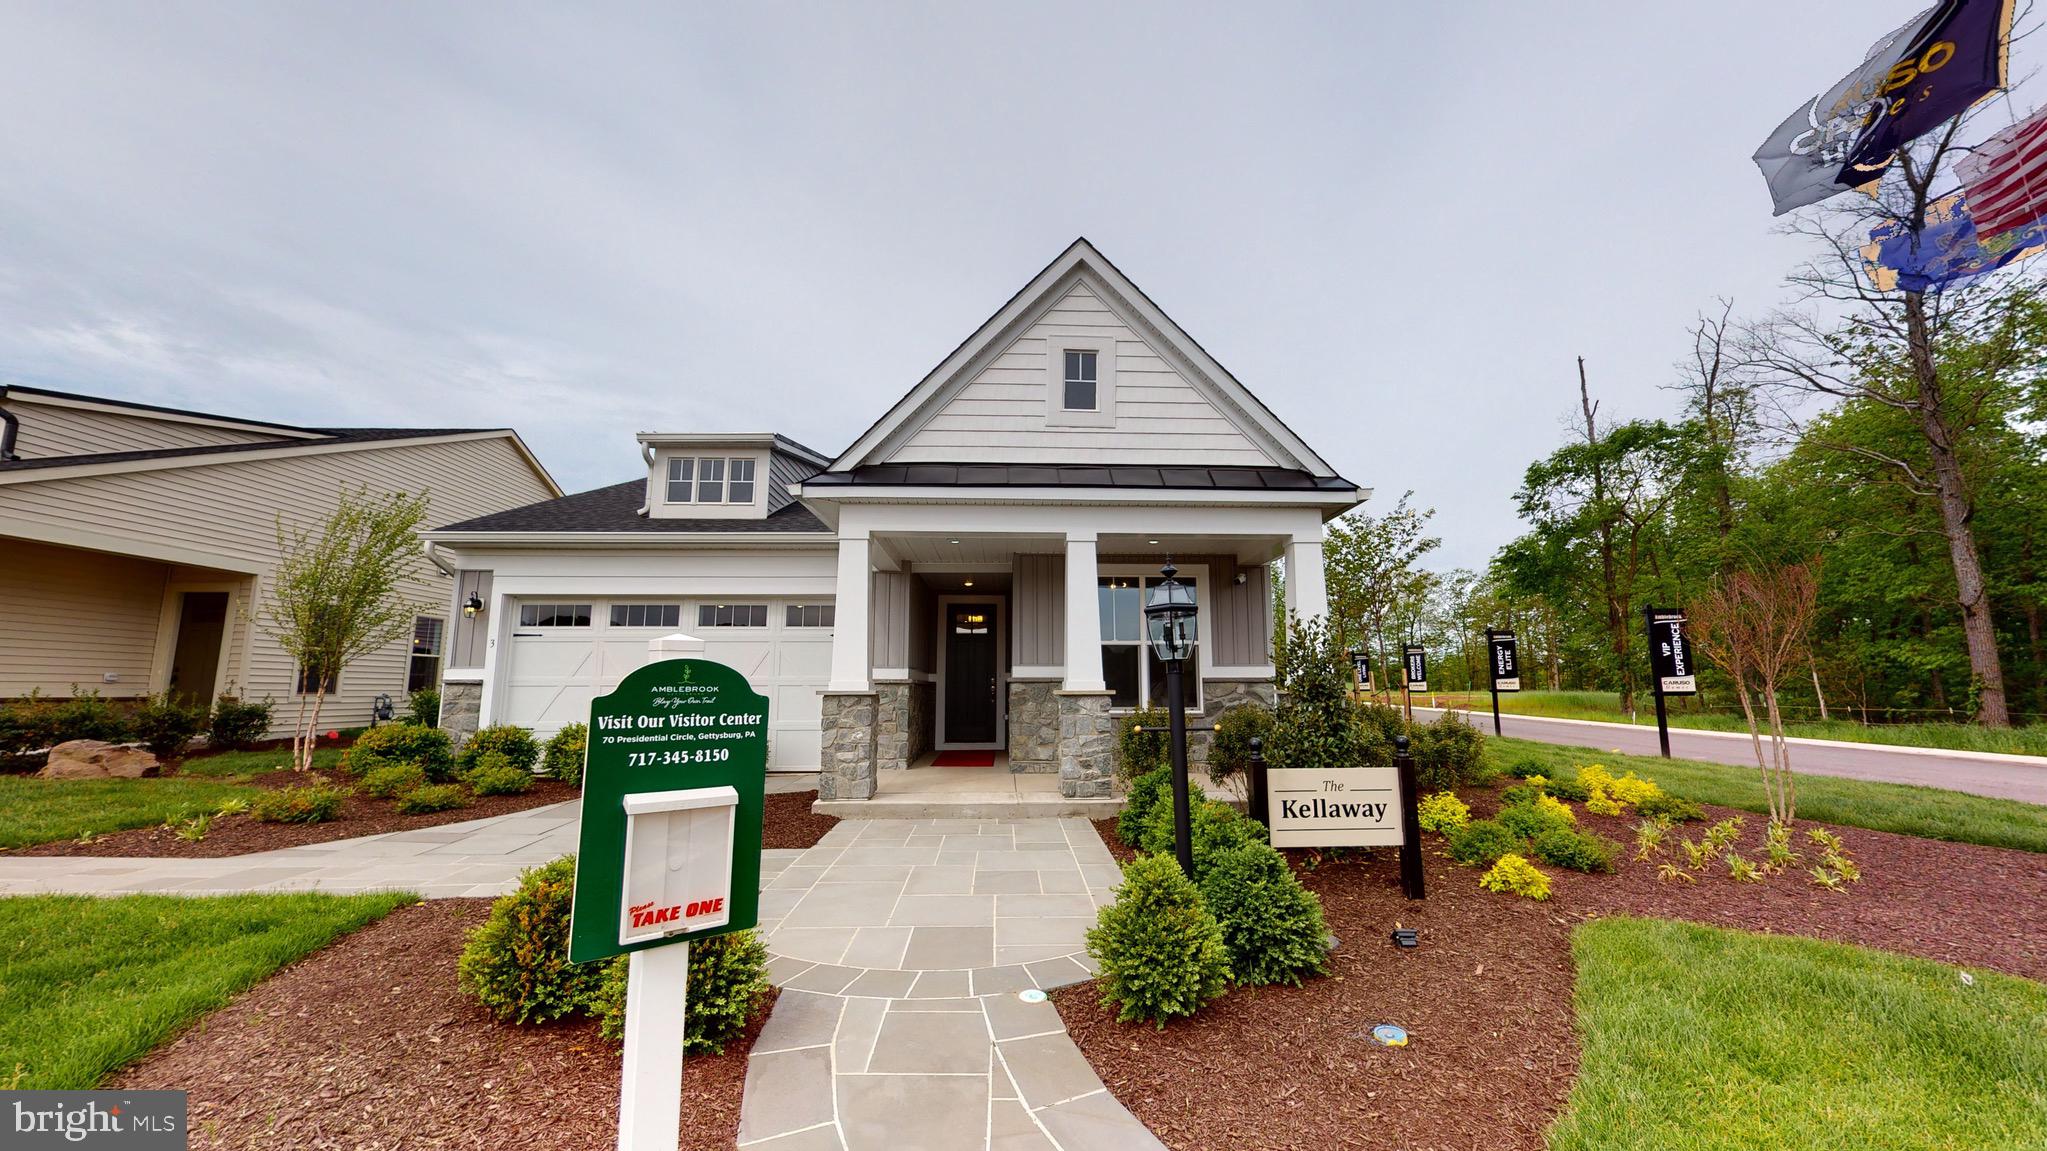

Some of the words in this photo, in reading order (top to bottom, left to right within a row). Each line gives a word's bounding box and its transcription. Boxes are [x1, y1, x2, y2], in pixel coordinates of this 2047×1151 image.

[1661, 642, 1671, 657] VIP
[1670, 623, 1686, 676] EXPERIENCE
[1496, 645, 1505, 675] ENERGY
[1504, 649, 1513, 670] ELITE
[671, 697, 687, 709] Your
[598, 715, 633, 730] Visit
[637, 715, 665, 729] Our
[669, 713, 716, 728] Visitor
[719, 712, 762, 726] Center
[602, 736, 615, 744] 70
[617, 733, 668, 744] Presidential
[670, 732, 696, 741] Circle,
[698, 731, 744, 742] Gettysburg,
[628, 748, 729, 767] 717-345-8150
[1322, 780, 1344, 792] The
[1281, 798, 1387, 823] Kellaway
[629, 901, 654, 916] Please
[633, 905, 681, 928] TAKE
[685, 898, 724, 918] ONE
